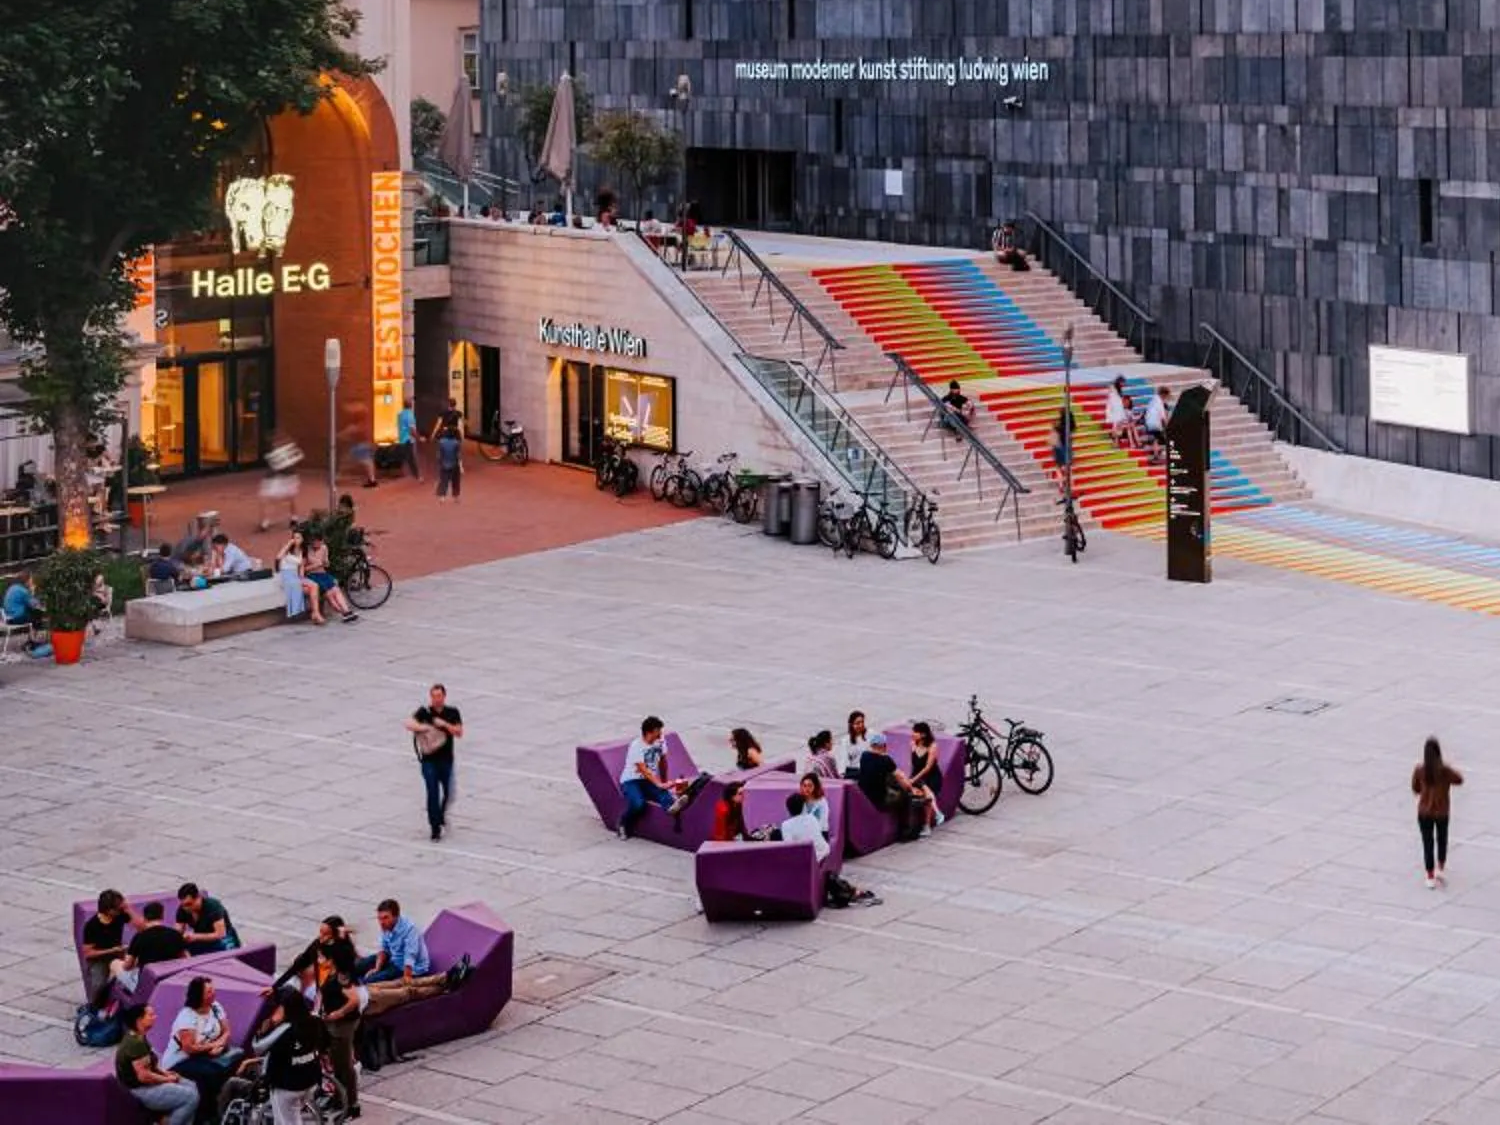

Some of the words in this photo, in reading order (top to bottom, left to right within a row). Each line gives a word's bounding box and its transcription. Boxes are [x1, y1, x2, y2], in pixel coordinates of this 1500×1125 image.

[735, 61, 788, 79] museum
[791, 57, 855, 79] moderner
[858, 57, 898, 81] kunst
[899, 56, 956, 85] stiftung
[959, 57, 1009, 86] ludwig
[1012, 57, 1049, 81] wien
[191, 267, 275, 298] Halle
[374, 173, 402, 381] FESTWOCHEN
[539, 316, 607, 353] Kunsthalle
[607, 327, 645, 357] Wien
